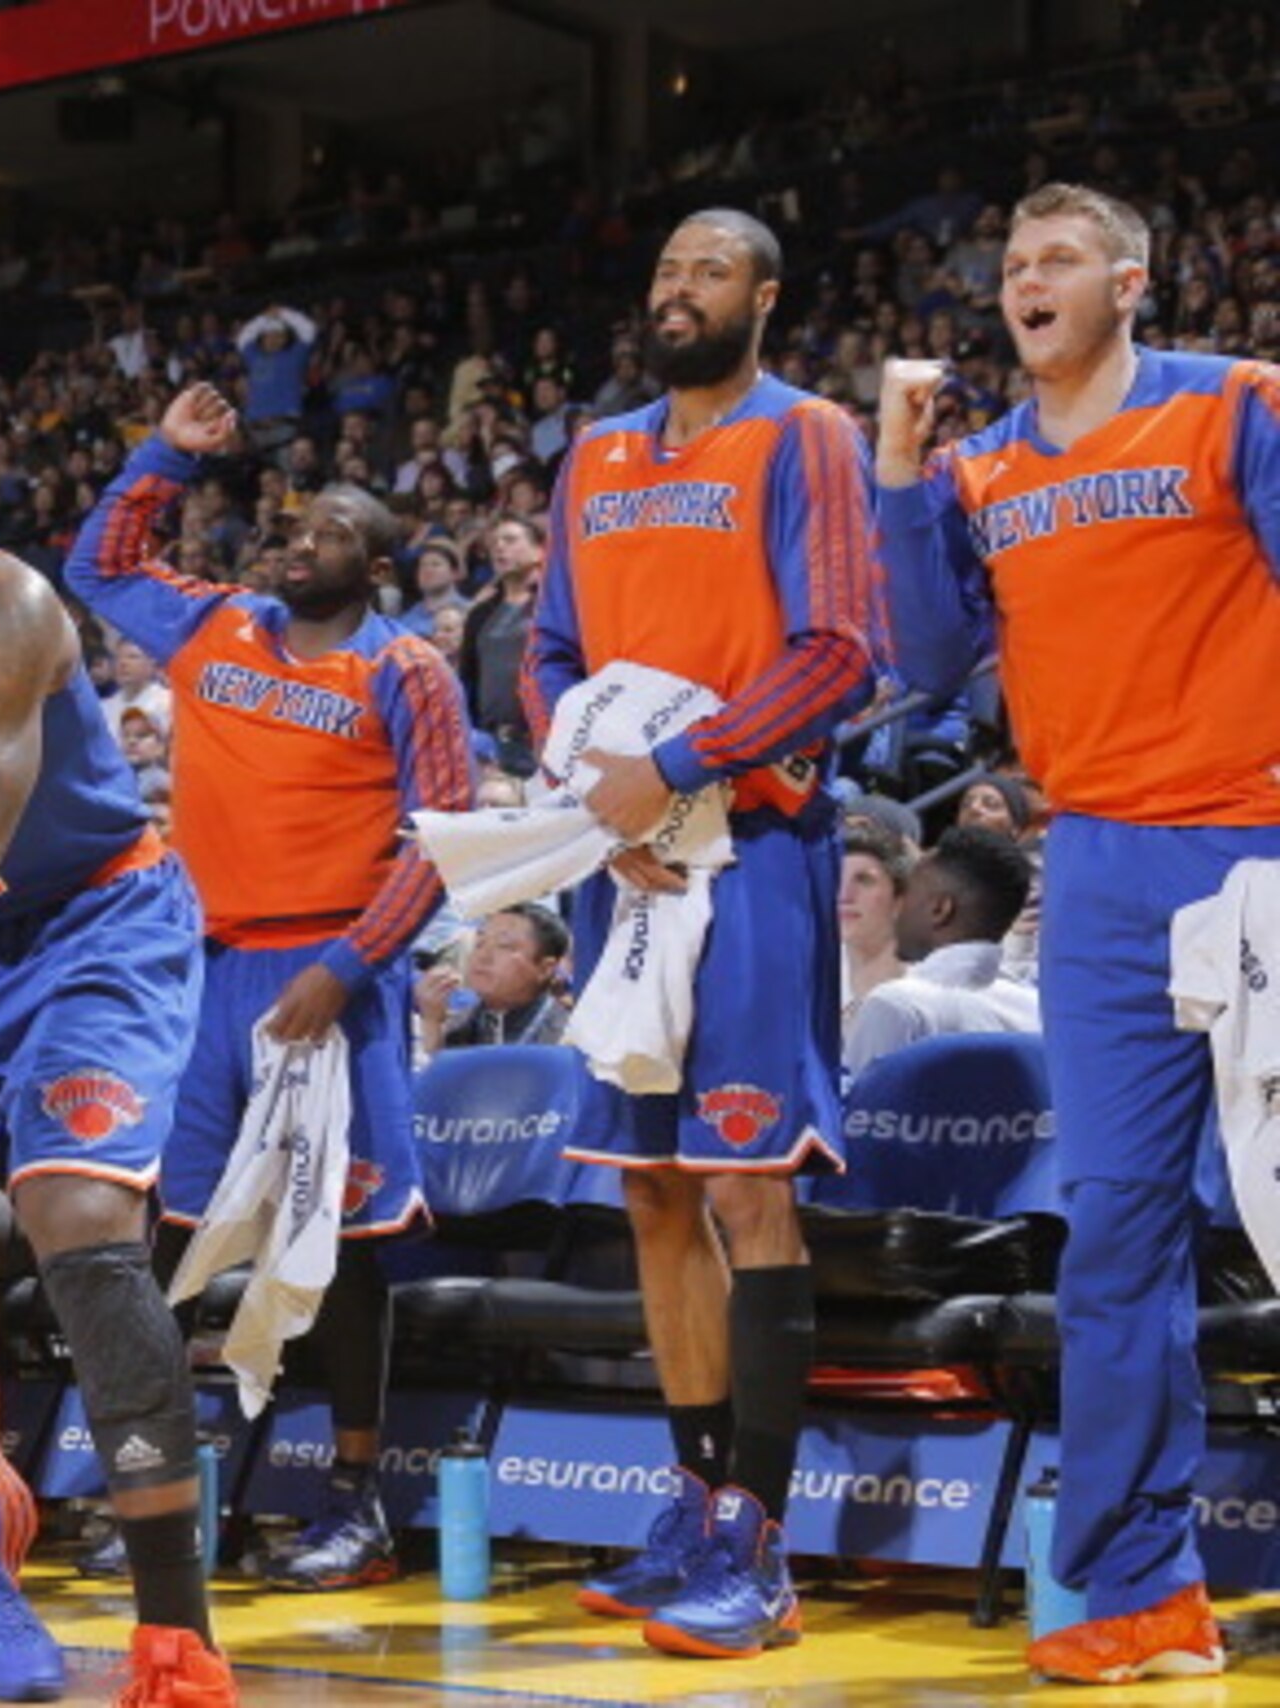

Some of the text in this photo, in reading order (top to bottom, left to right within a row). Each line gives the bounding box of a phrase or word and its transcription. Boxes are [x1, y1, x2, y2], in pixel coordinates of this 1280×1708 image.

[969, 464, 1193, 561] NEW YORK
[196, 661, 364, 740] NEW YORK
[412, 1110, 561, 1143] surance
[843, 1109, 1056, 1144] esurance
[497, 1456, 683, 1498] esuranc
